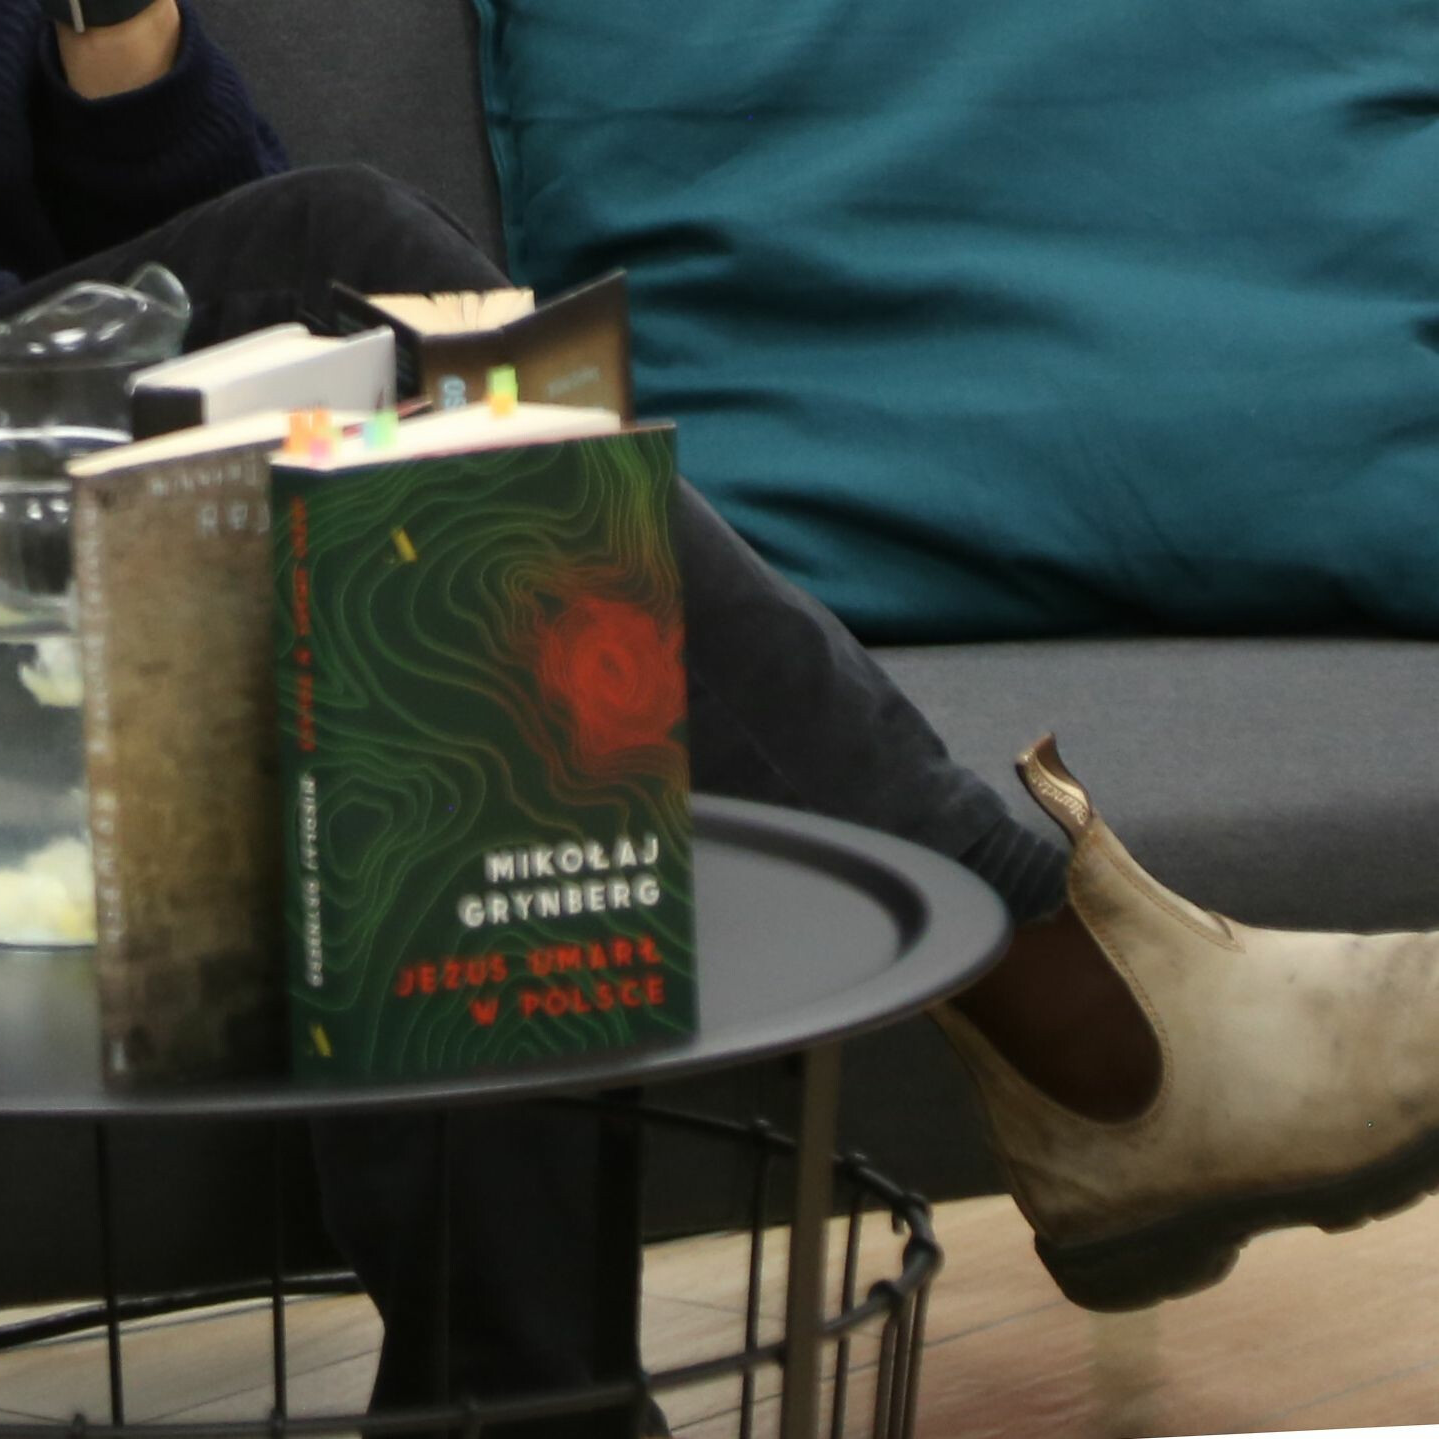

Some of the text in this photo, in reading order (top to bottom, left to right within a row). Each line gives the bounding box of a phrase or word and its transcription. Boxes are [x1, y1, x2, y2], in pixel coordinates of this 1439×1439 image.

[484, 831, 659, 884] MIKOŁAJ
[457, 872, 662, 929] GRYNBERG
[517, 973, 666, 1022] POLSCE
